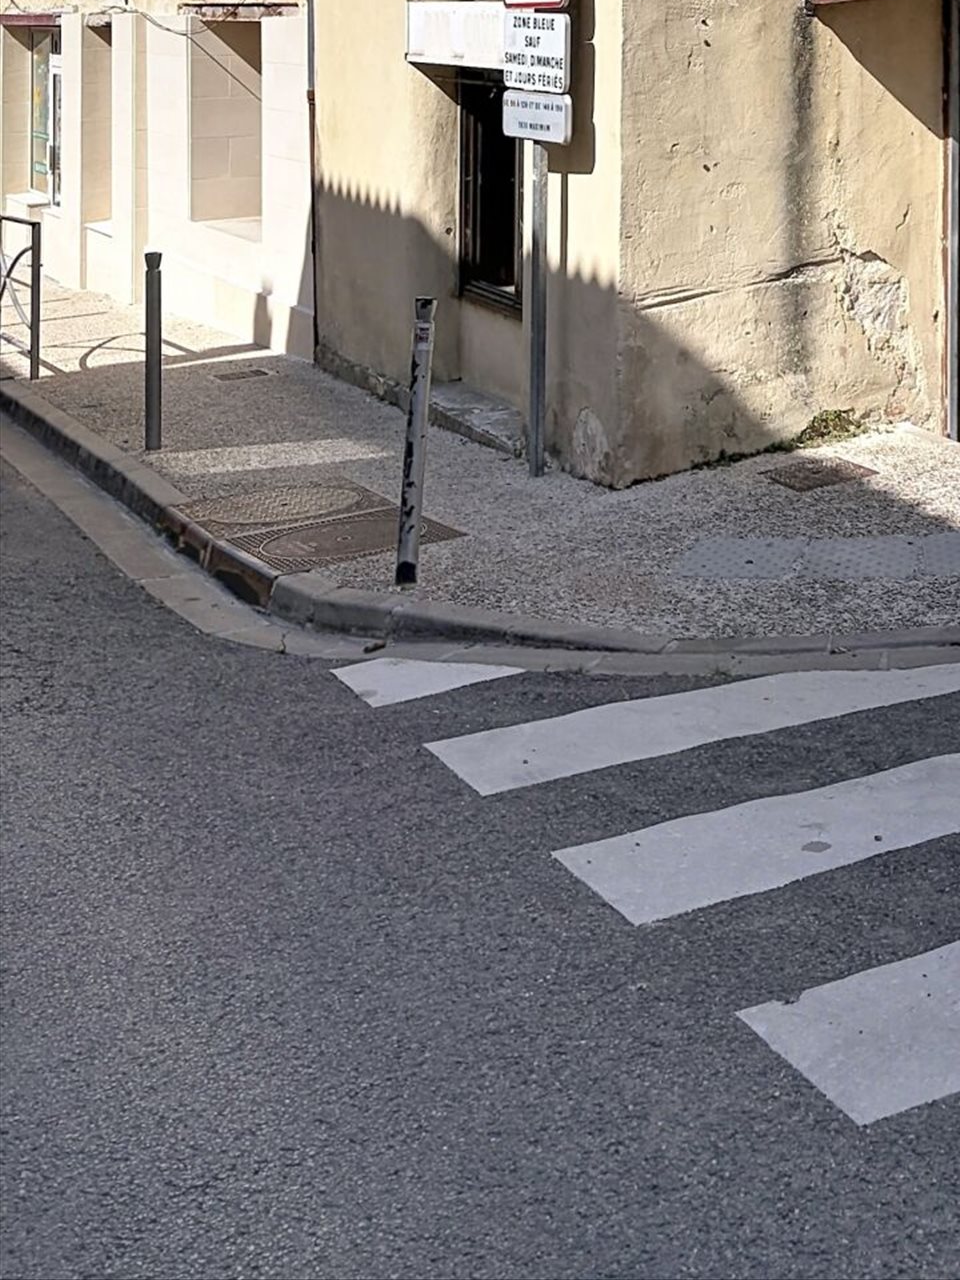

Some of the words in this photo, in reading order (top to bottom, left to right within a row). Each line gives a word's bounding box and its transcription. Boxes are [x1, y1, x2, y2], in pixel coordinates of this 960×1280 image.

[513, 15, 531, 29] ZONE
[533, 17, 555, 31] BLEUE
[524, 35, 541, 48] SAUF
[530, 54, 563, 70] DIMANCHE
[505, 70, 512, 82] ET
[514, 72, 536, 85] JOURS
[538, 72, 563, 89] FÉRIÉS
